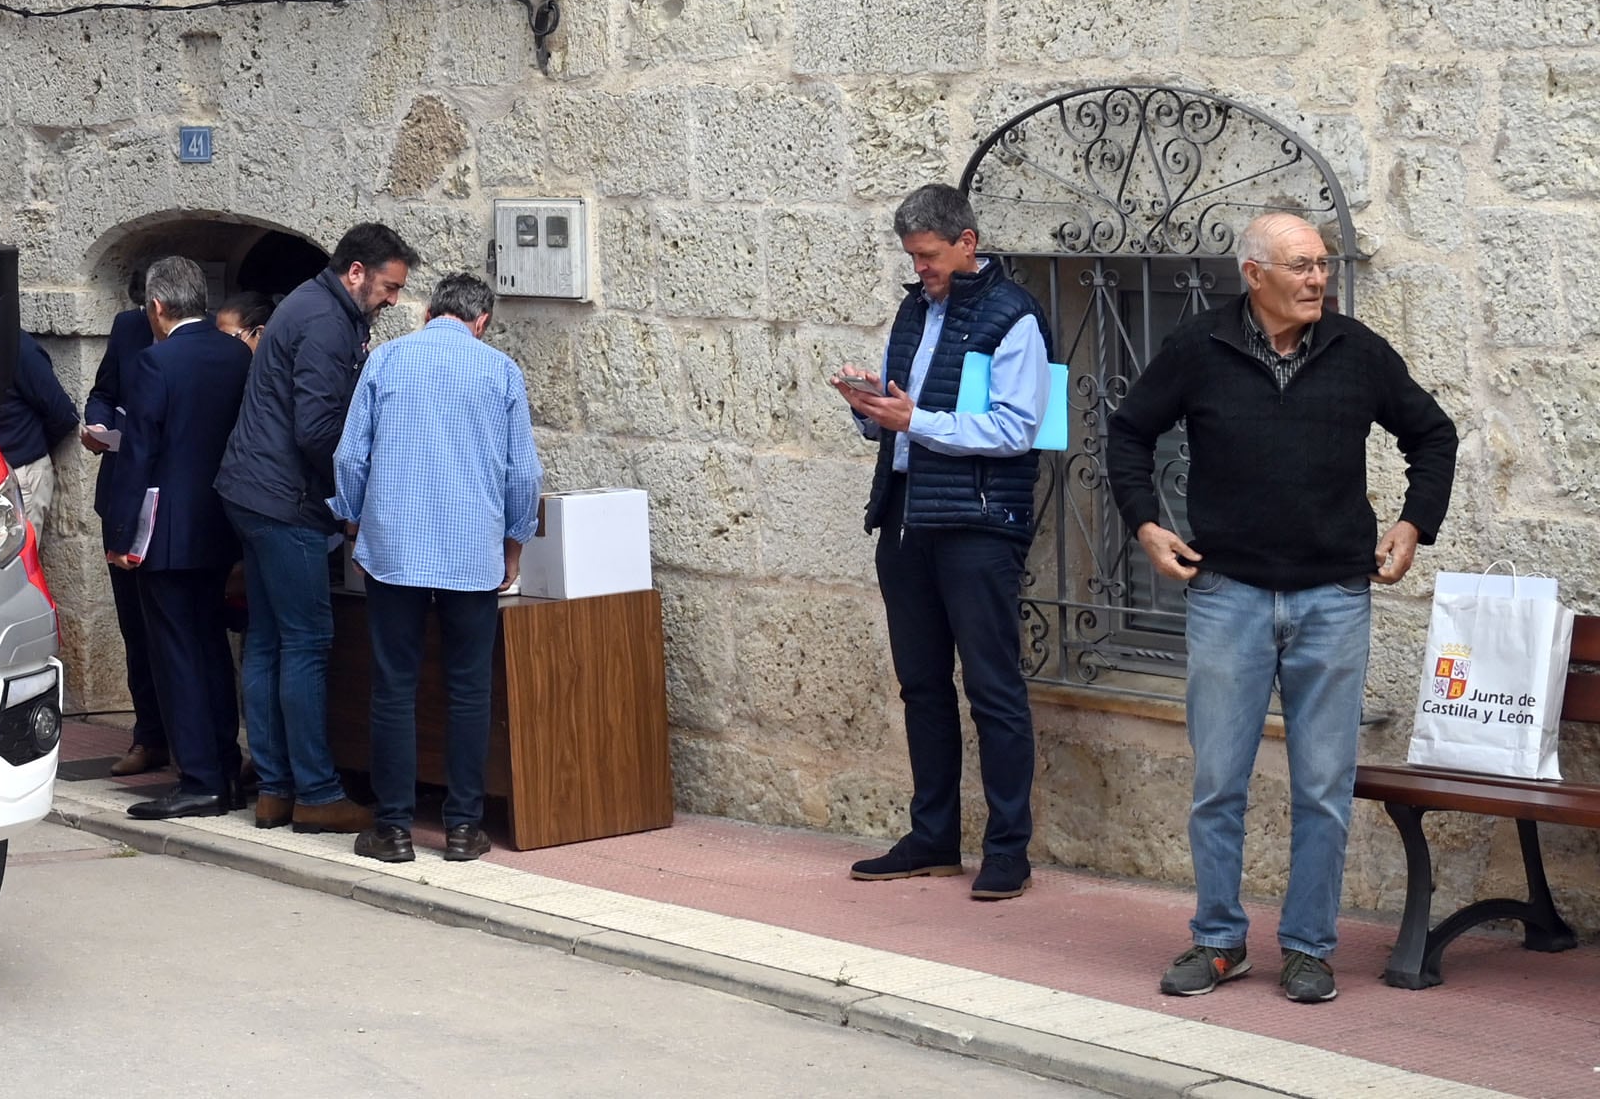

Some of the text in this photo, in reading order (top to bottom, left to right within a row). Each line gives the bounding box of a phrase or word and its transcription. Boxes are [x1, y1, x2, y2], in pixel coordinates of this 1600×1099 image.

[188, 132, 203, 157] 41
[1468, 689, 1536, 707] Junta de
[1422, 699, 1535, 725] Castilla y León
